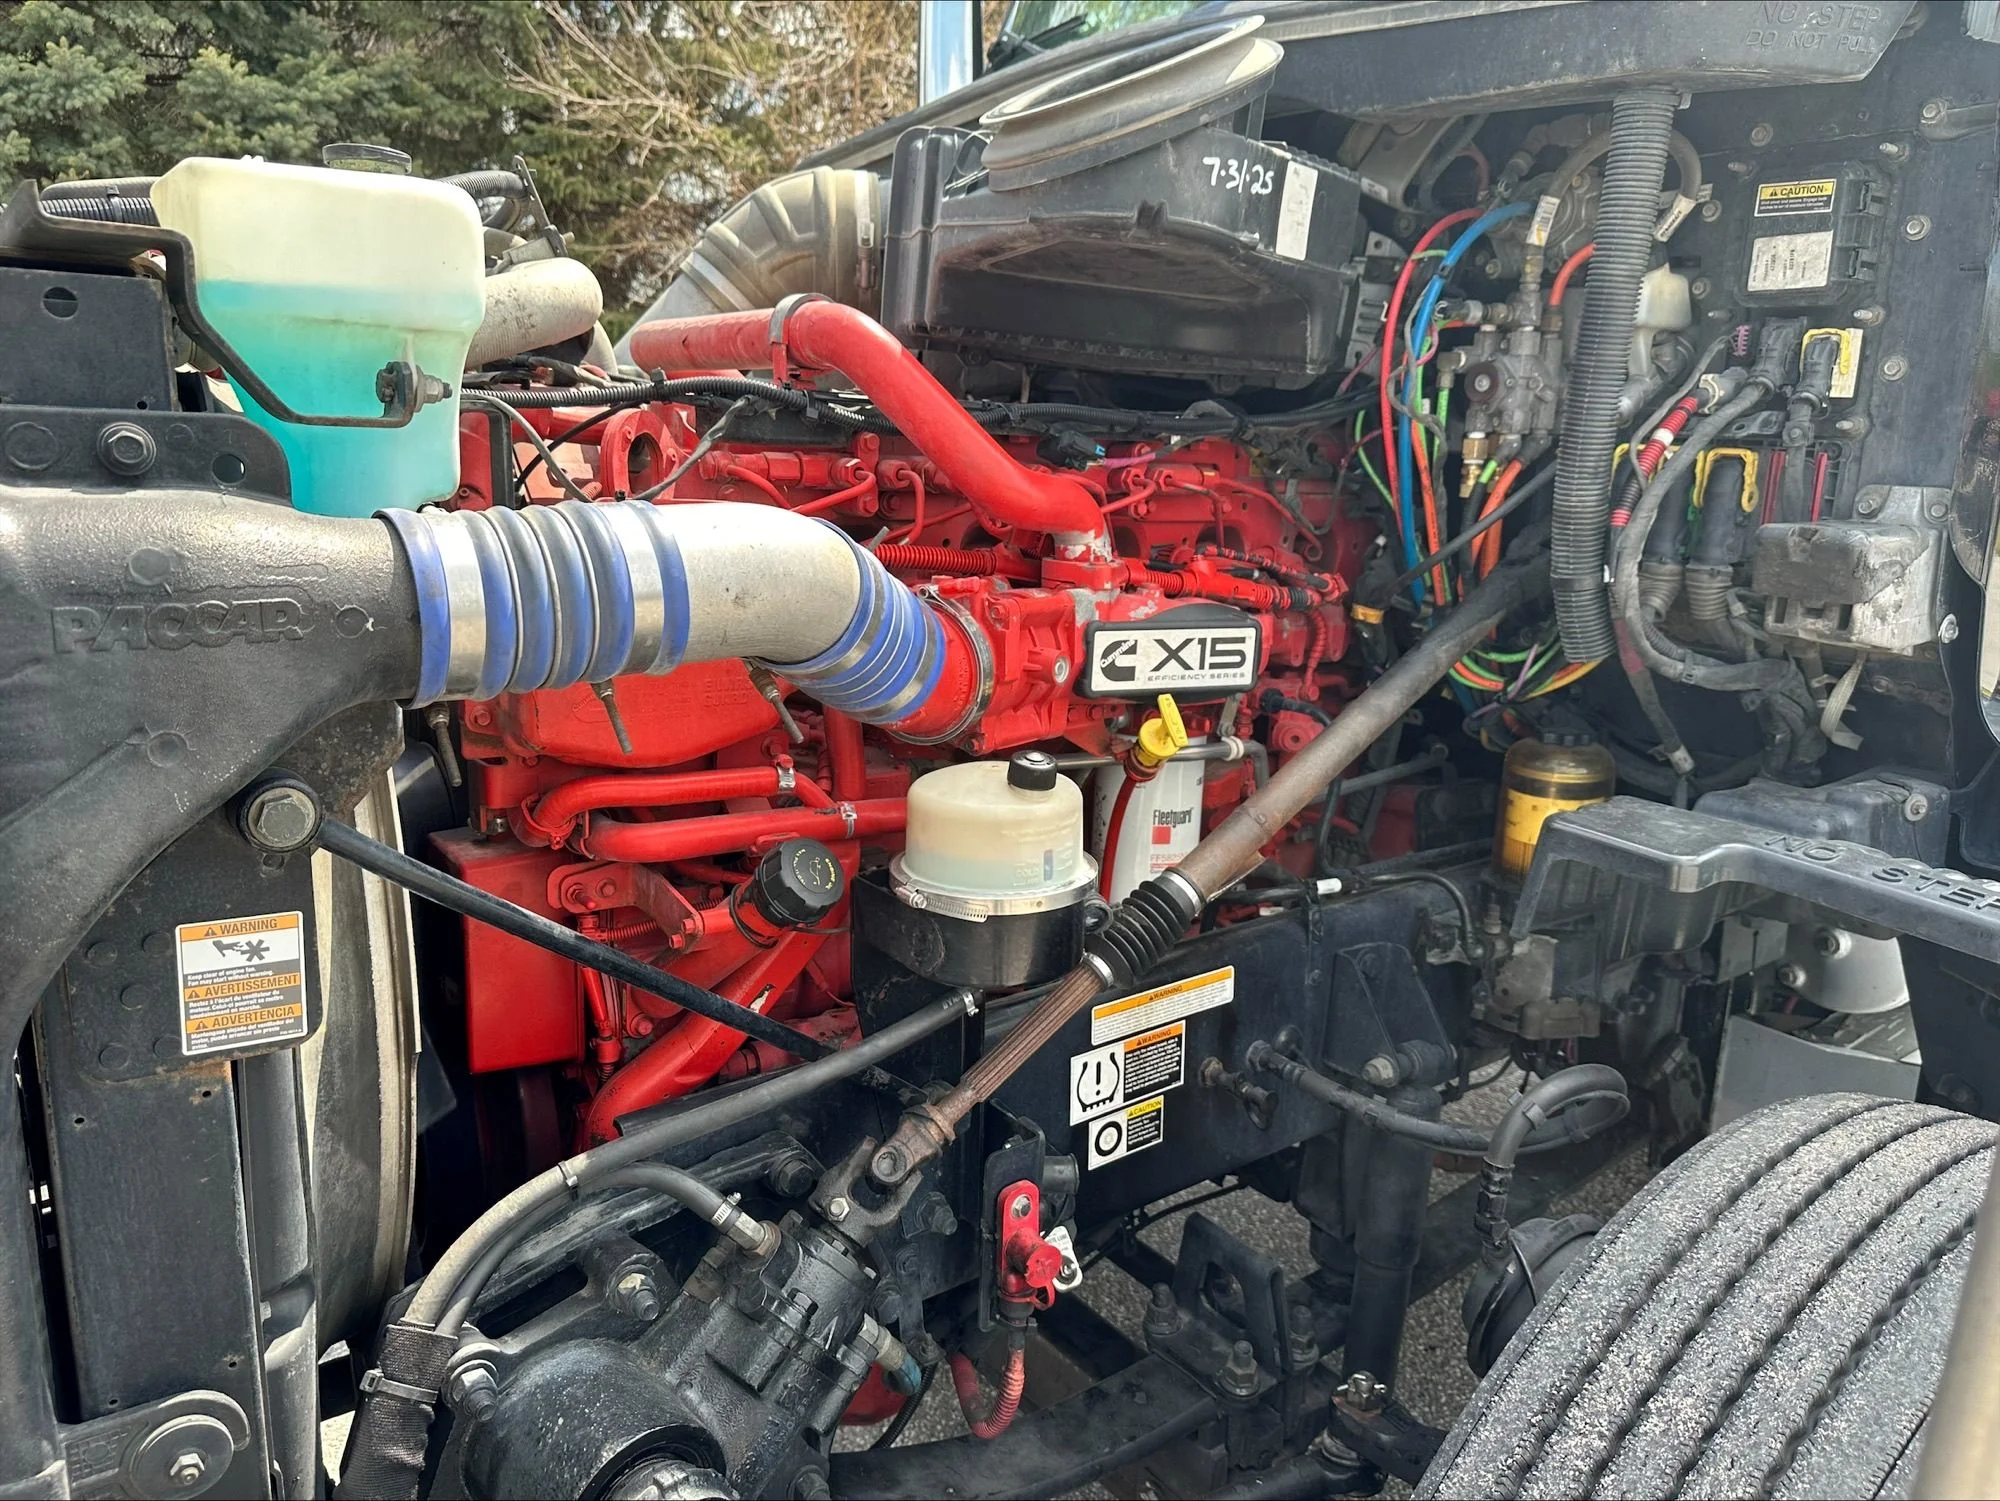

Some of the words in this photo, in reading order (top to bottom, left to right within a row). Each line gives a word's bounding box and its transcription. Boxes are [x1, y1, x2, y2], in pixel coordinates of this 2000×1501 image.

[1816, 2, 1881, 31] STEP
[1745, 29, 1777, 46] DO
[1786, 31, 1829, 48] NOT
[1780, 184, 1825, 197] CAUTION
[51, 597, 304, 655] PACCAR
[1149, 636, 1247, 673] X15
[1147, 673, 1206, 682] EFFICIENCY
[1209, 672, 1246, 680] SERIES
[219, 918, 278, 935] WARNING
[204, 974, 299, 997] AVERTISSEMENT
[1153, 985, 1183, 1000] WARNING
[212, 1006, 295, 1028] ADVERTENCIA
[1141, 1029, 1172, 1045] WARNING
[1133, 1100, 1162, 1114] CAUTION
